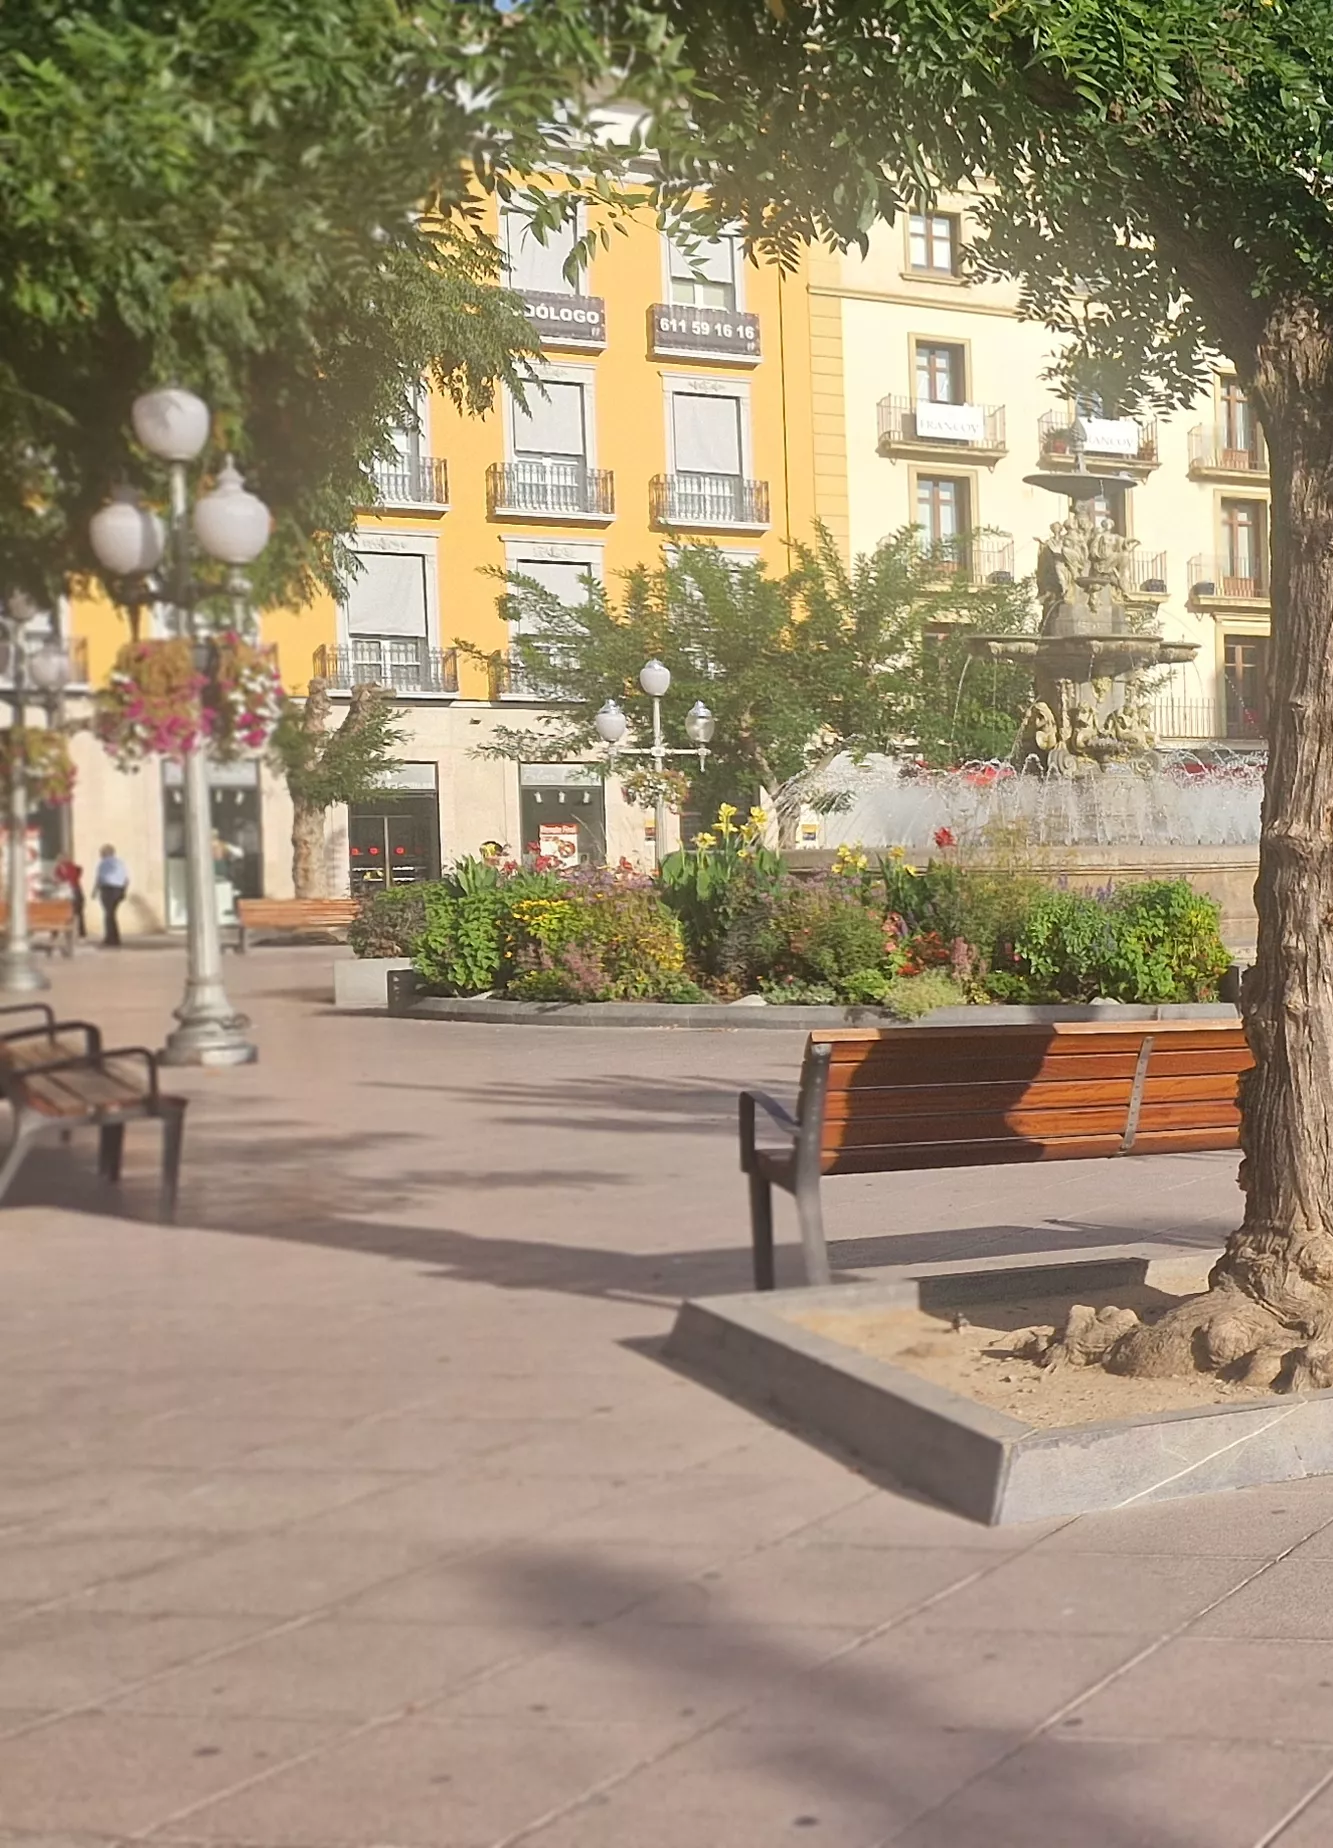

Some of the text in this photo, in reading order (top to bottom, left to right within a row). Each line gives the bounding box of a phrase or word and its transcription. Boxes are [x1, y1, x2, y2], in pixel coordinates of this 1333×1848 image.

[522, 302, 600, 325] DÓLOGO
[660, 317, 755, 340] 611 59 16 16
